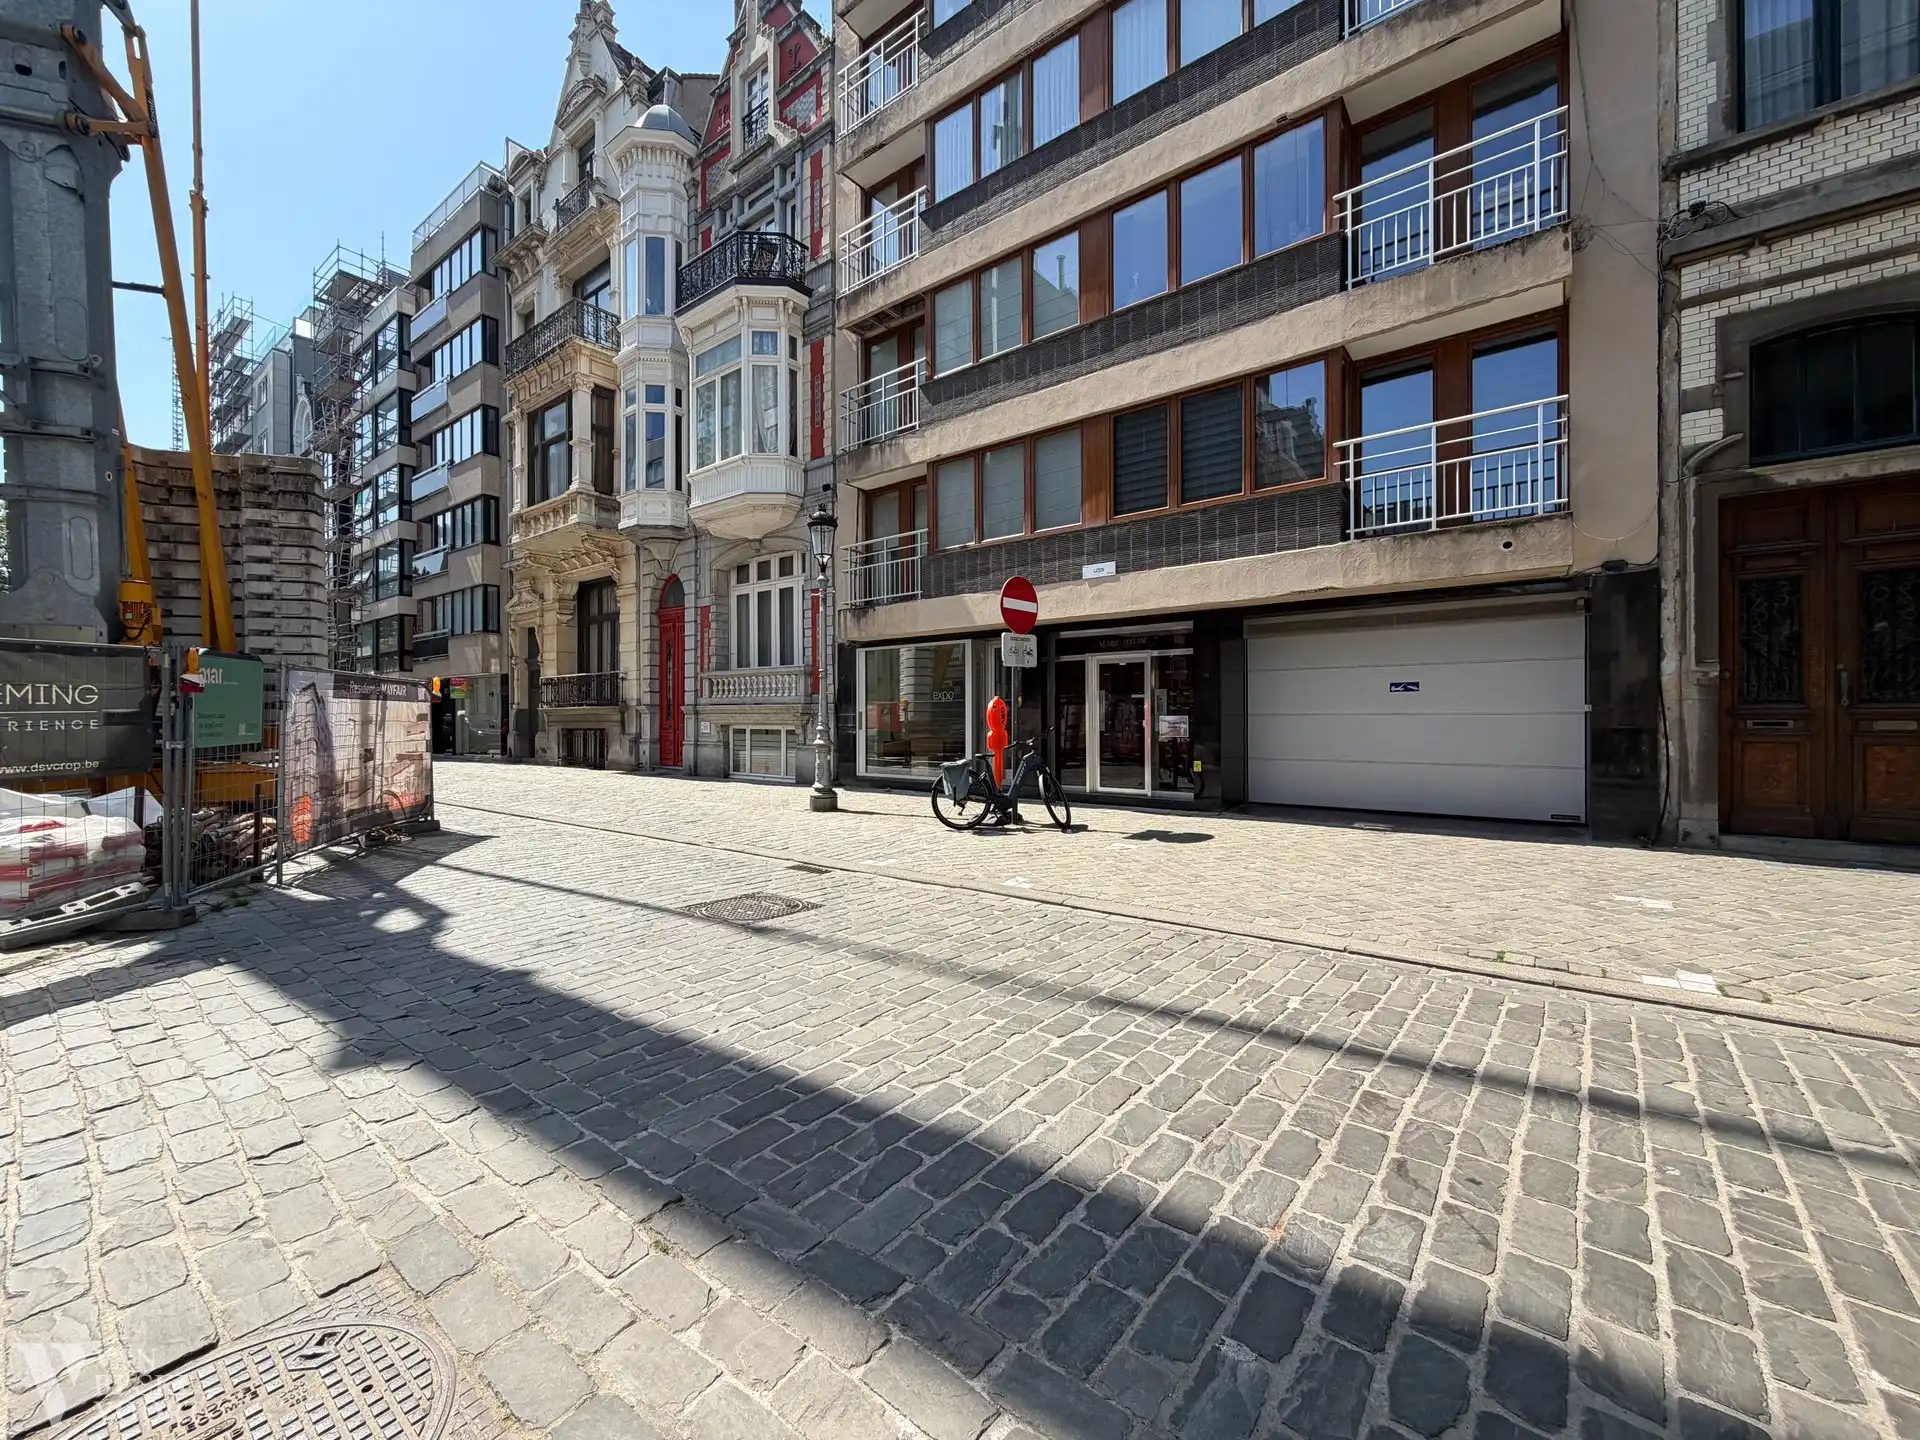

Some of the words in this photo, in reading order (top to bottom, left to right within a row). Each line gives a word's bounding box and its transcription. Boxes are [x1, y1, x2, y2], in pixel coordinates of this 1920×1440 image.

[0, 683, 99, 705] MING
[349, 680, 380, 694] Residente
[380, 683, 407, 697] MAYFAIR
[932, 691, 954, 702] expo
[7, 719, 99, 732] RIENCE
[169, 1383, 262, 1433] FONDATEL
